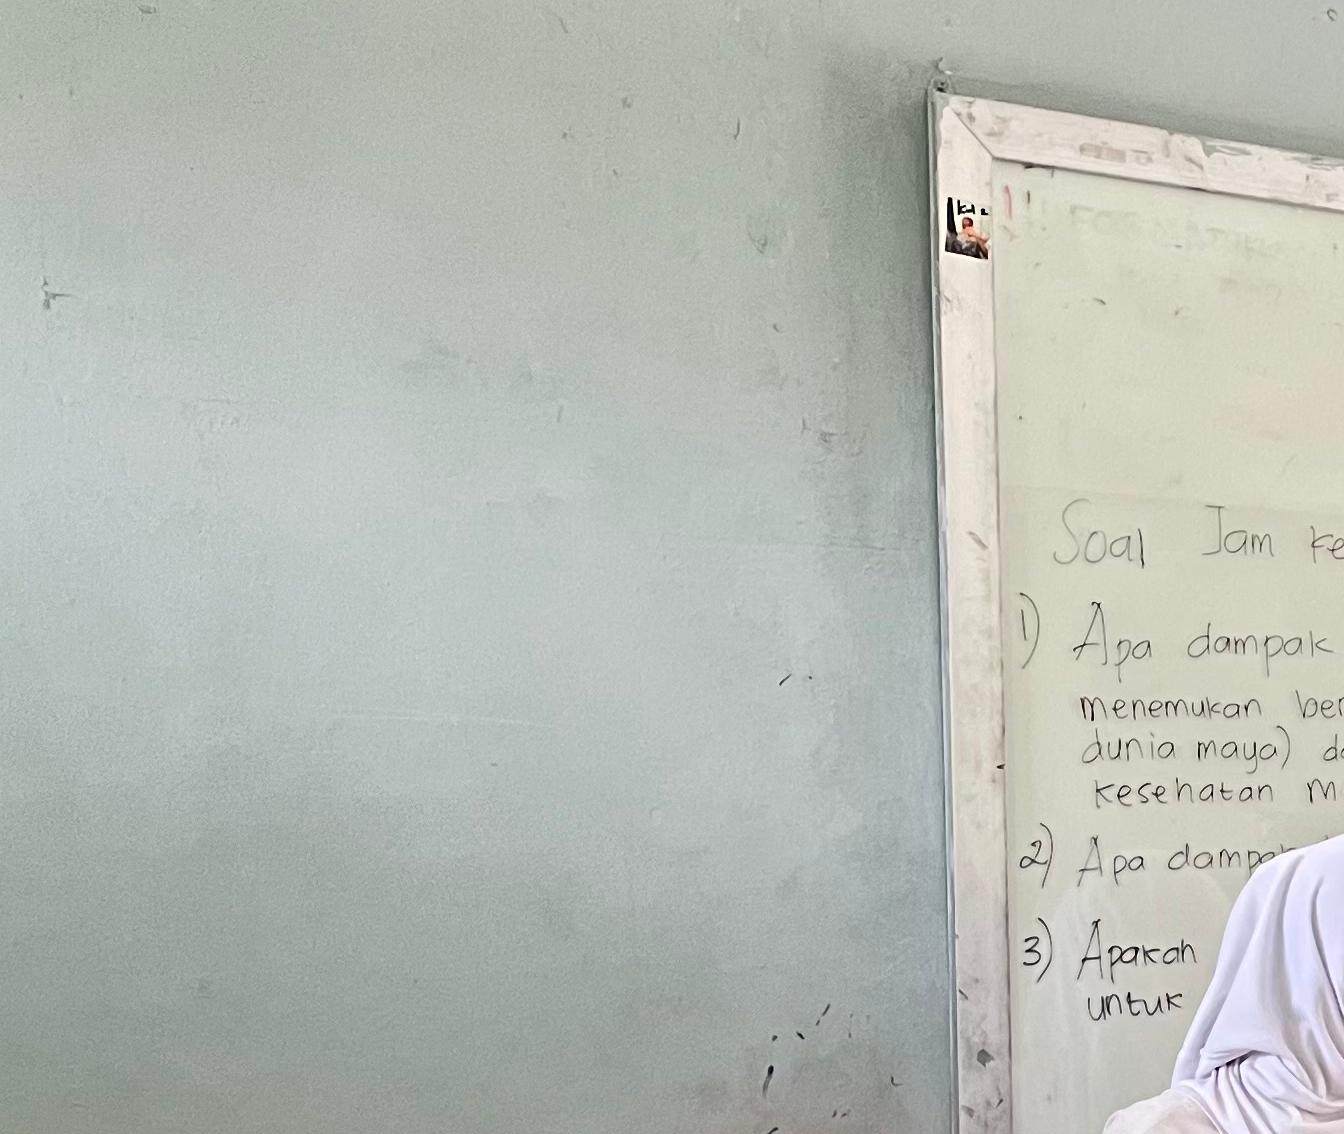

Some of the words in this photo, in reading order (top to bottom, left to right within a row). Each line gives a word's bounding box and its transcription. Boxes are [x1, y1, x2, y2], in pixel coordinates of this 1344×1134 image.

[1053, 498, 1144, 567] Soal
[1202, 504, 1274, 557] Jam
[1019, 592, 1040, 669] 1)
[1073, 601, 1153, 682] Apa
[1187, 622, 1334, 677] dampak
[1080, 696, 1262, 720] menemukan
[1081, 728, 1176, 764] dunia
[1197, 725, 1291, 773] maya)
[1094, 777, 1274, 809] kesehatan
[1019, 823, 1054, 888] 2)
[1078, 835, 1145, 887] Apa
[1168, 843, 1297, 877] dampa
[1022, 917, 1053, 983] 3)
[1077, 918, 1198, 983] Apakah
[1088, 991, 1183, 1021] untuk
